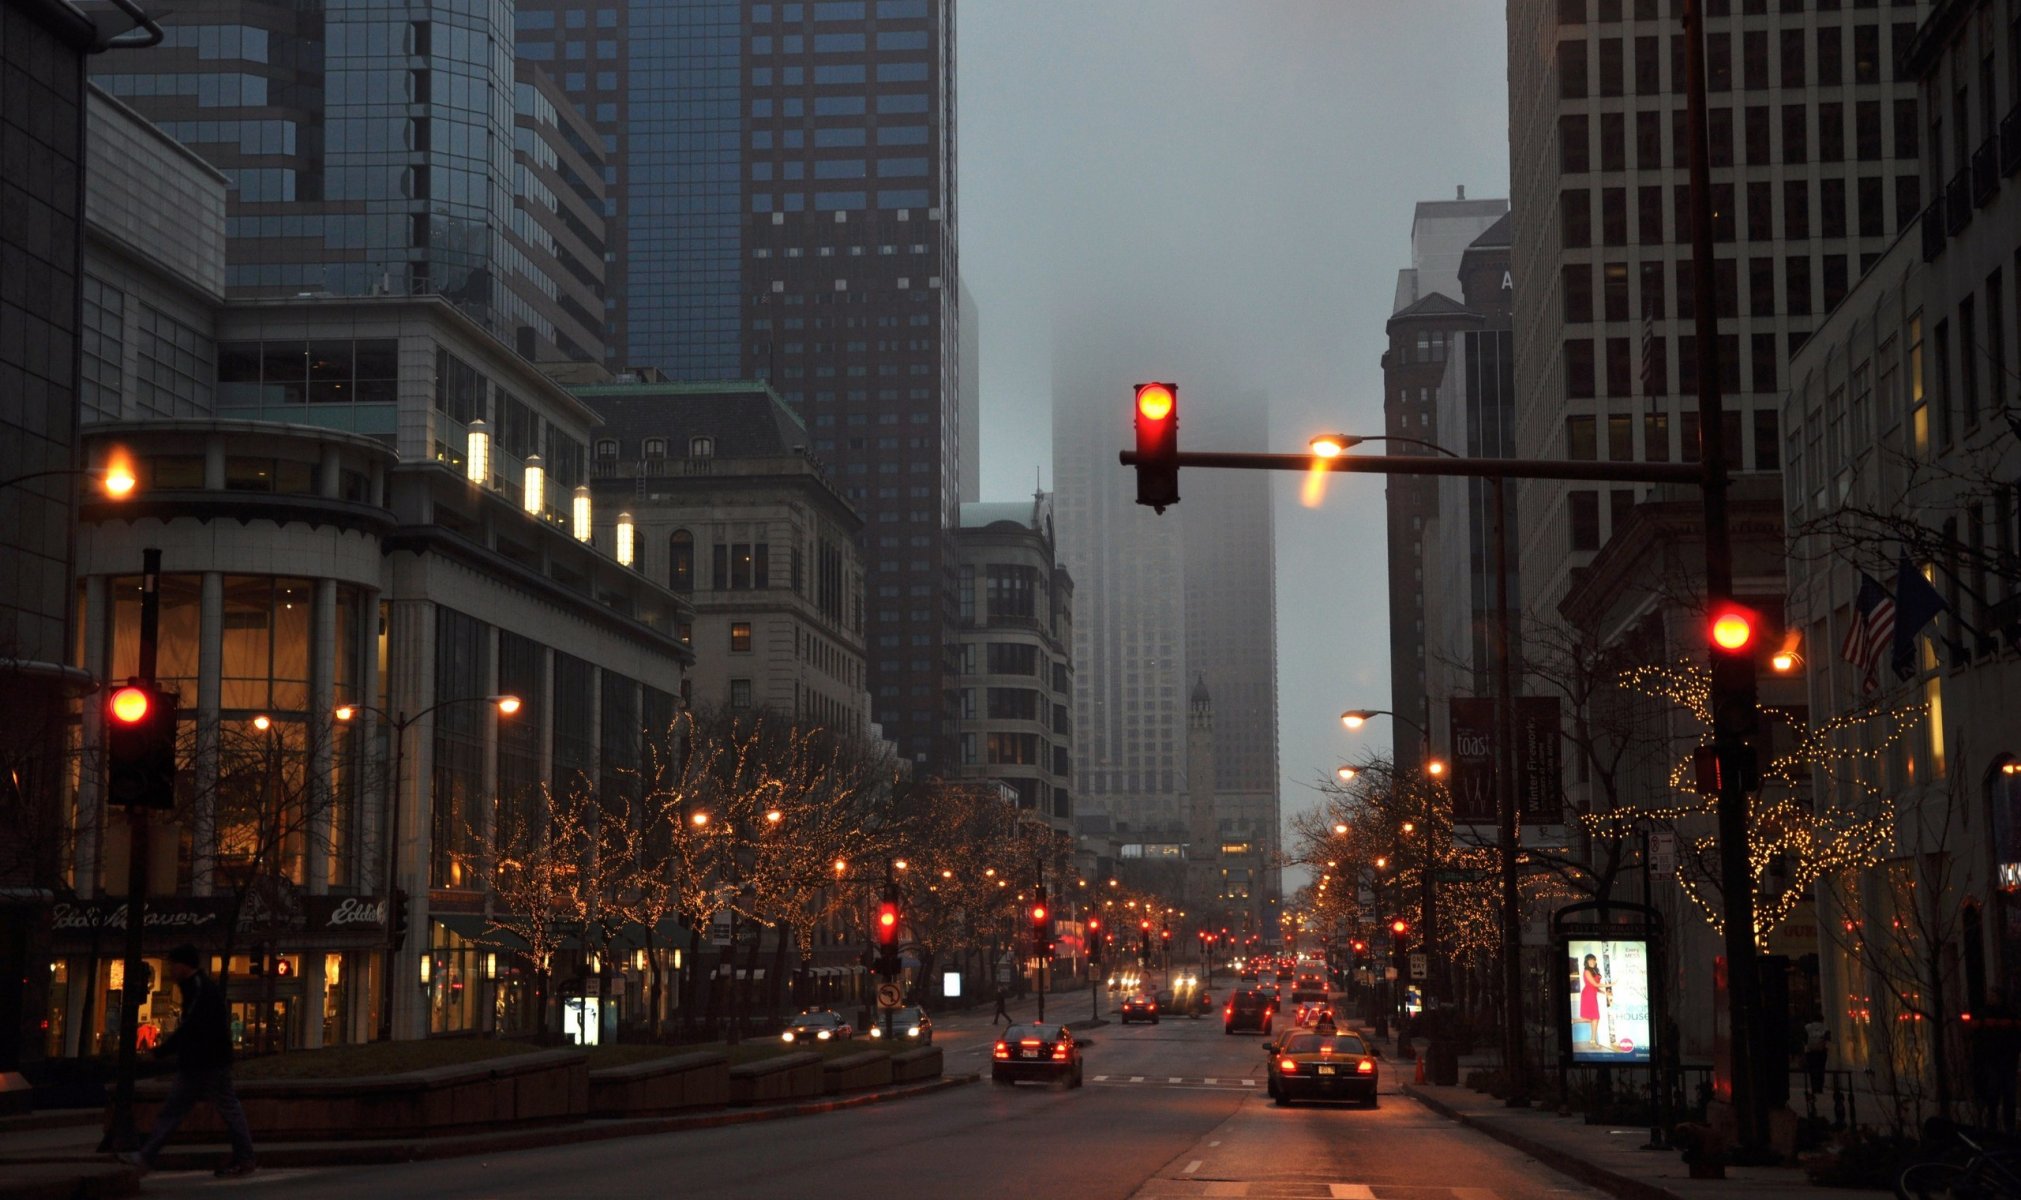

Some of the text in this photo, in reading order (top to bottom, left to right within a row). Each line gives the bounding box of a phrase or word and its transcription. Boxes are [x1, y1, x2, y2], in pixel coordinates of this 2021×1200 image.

[1456, 733, 1492, 756] toast
[1528, 774, 1539, 813] Winter
[325, 898, 377, 927] Eddie
